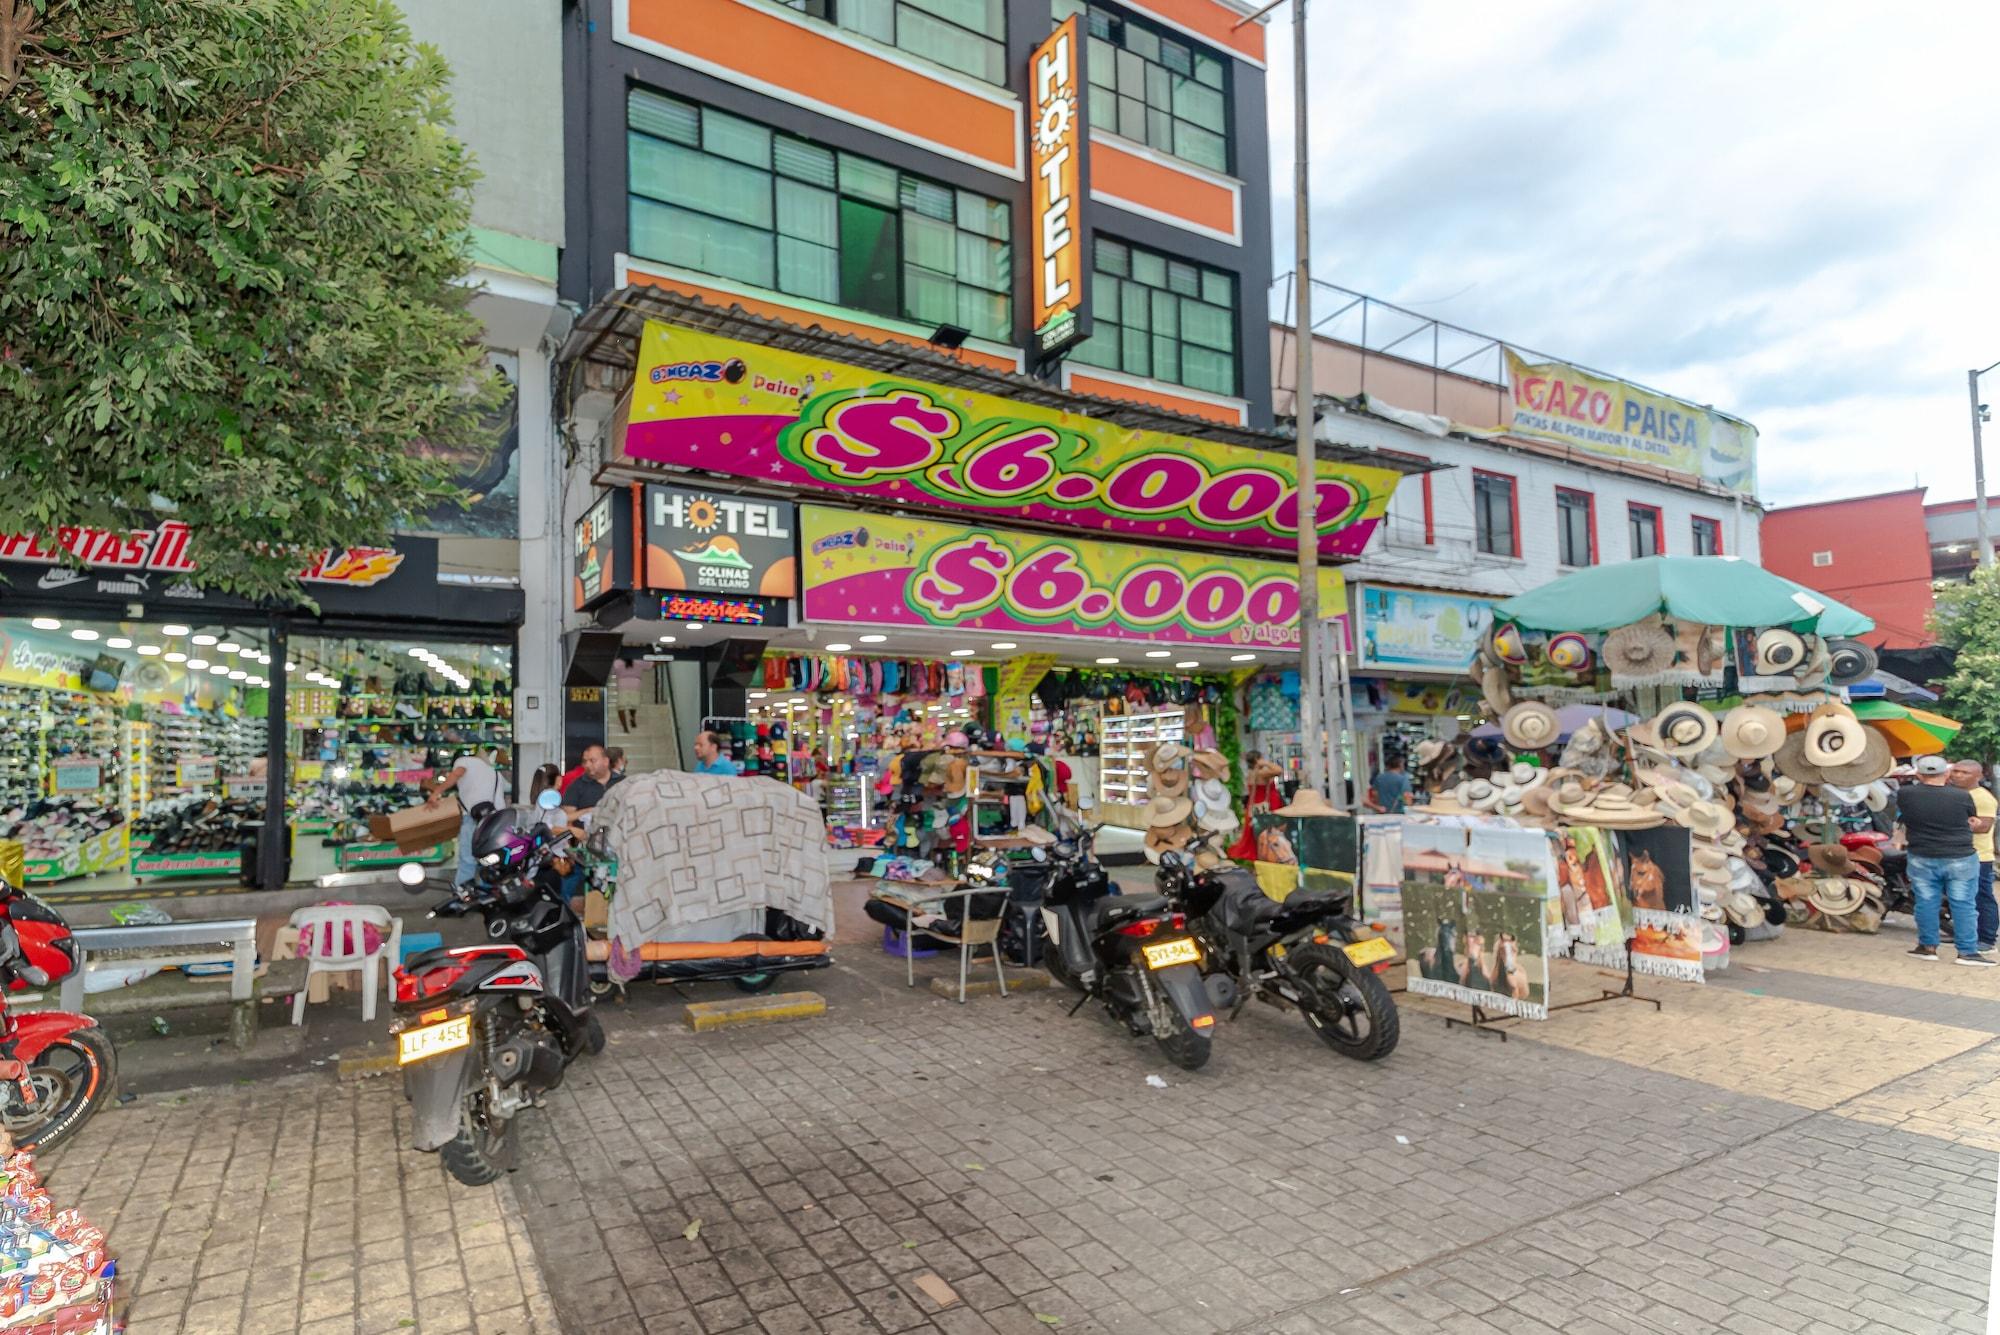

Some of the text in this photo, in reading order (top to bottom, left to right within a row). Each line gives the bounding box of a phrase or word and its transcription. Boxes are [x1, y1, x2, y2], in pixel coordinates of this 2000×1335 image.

[1035, 32, 1073, 309] HOTEL
[753, 375, 800, 397] Paisa
[1566, 424, 1585, 438] POR
[1588, 428, 1621, 446] MAYOR
[1623, 399, 1698, 448] PAISA
[575, 495, 612, 557] HOTEL
[653, 492, 789, 539] HOTEL
[698, 566, 750, 580] COLINAS
[698, 577, 750, 590] DEL LLANO
[914, 538, 1300, 625] $6.000
[97, 579, 141, 595] PUMA
[1255, 620, 1289, 644] algo
